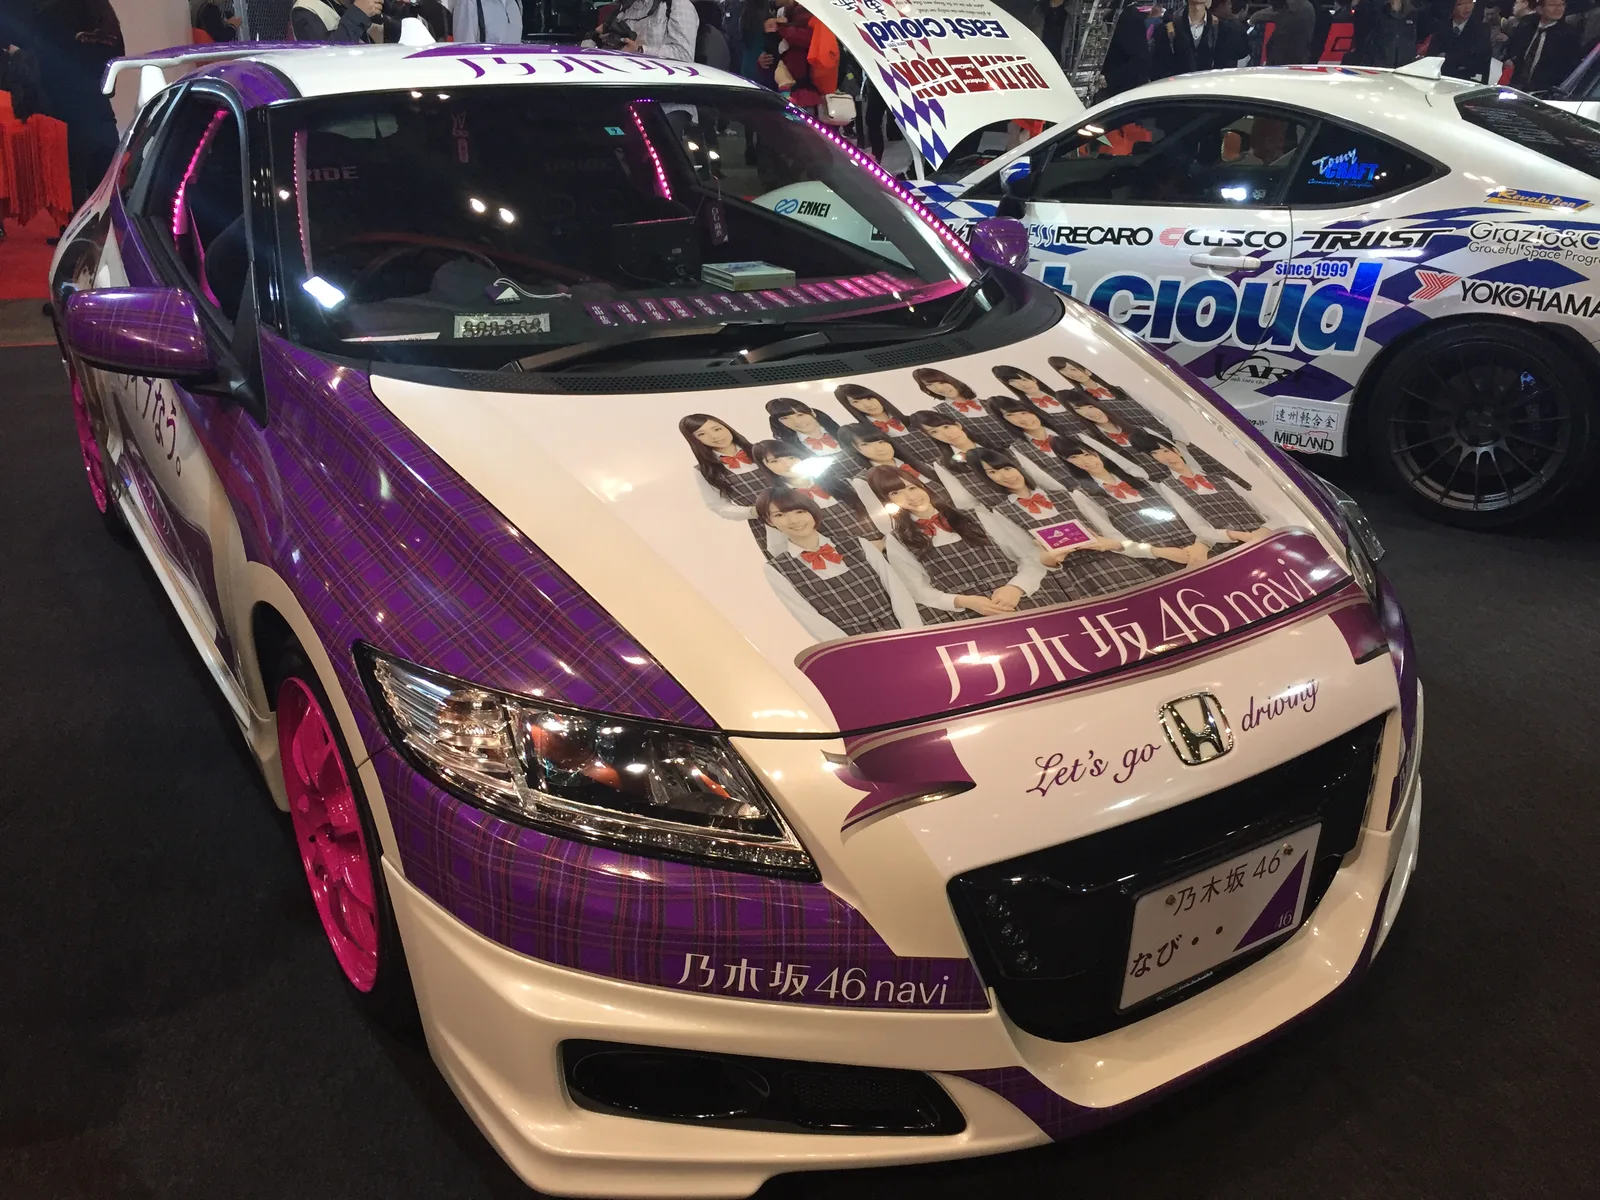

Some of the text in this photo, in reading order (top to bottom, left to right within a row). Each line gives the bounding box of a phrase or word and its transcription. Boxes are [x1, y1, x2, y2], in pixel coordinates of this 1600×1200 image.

[950, 18, 1010, 40] East
[1325, 162, 1379, 181] CRAFT
[797, 201, 831, 218] ENKEI
[1055, 226, 1154, 246] RECARO
[1183, 228, 1287, 249] CUSCO
[1302, 229, 1455, 250] TRUST
[1468, 241, 1520, 256] Graceful
[1523, 244, 1561, 260] Space
[1275, 261, 1348, 278] since 1999
[1273, 431, 1335, 452] MIDLAND
[1224, 558, 1319, 626] navi
[1026, 679, 1320, 797] Let's go driving
[874, 975, 950, 1005] navi
